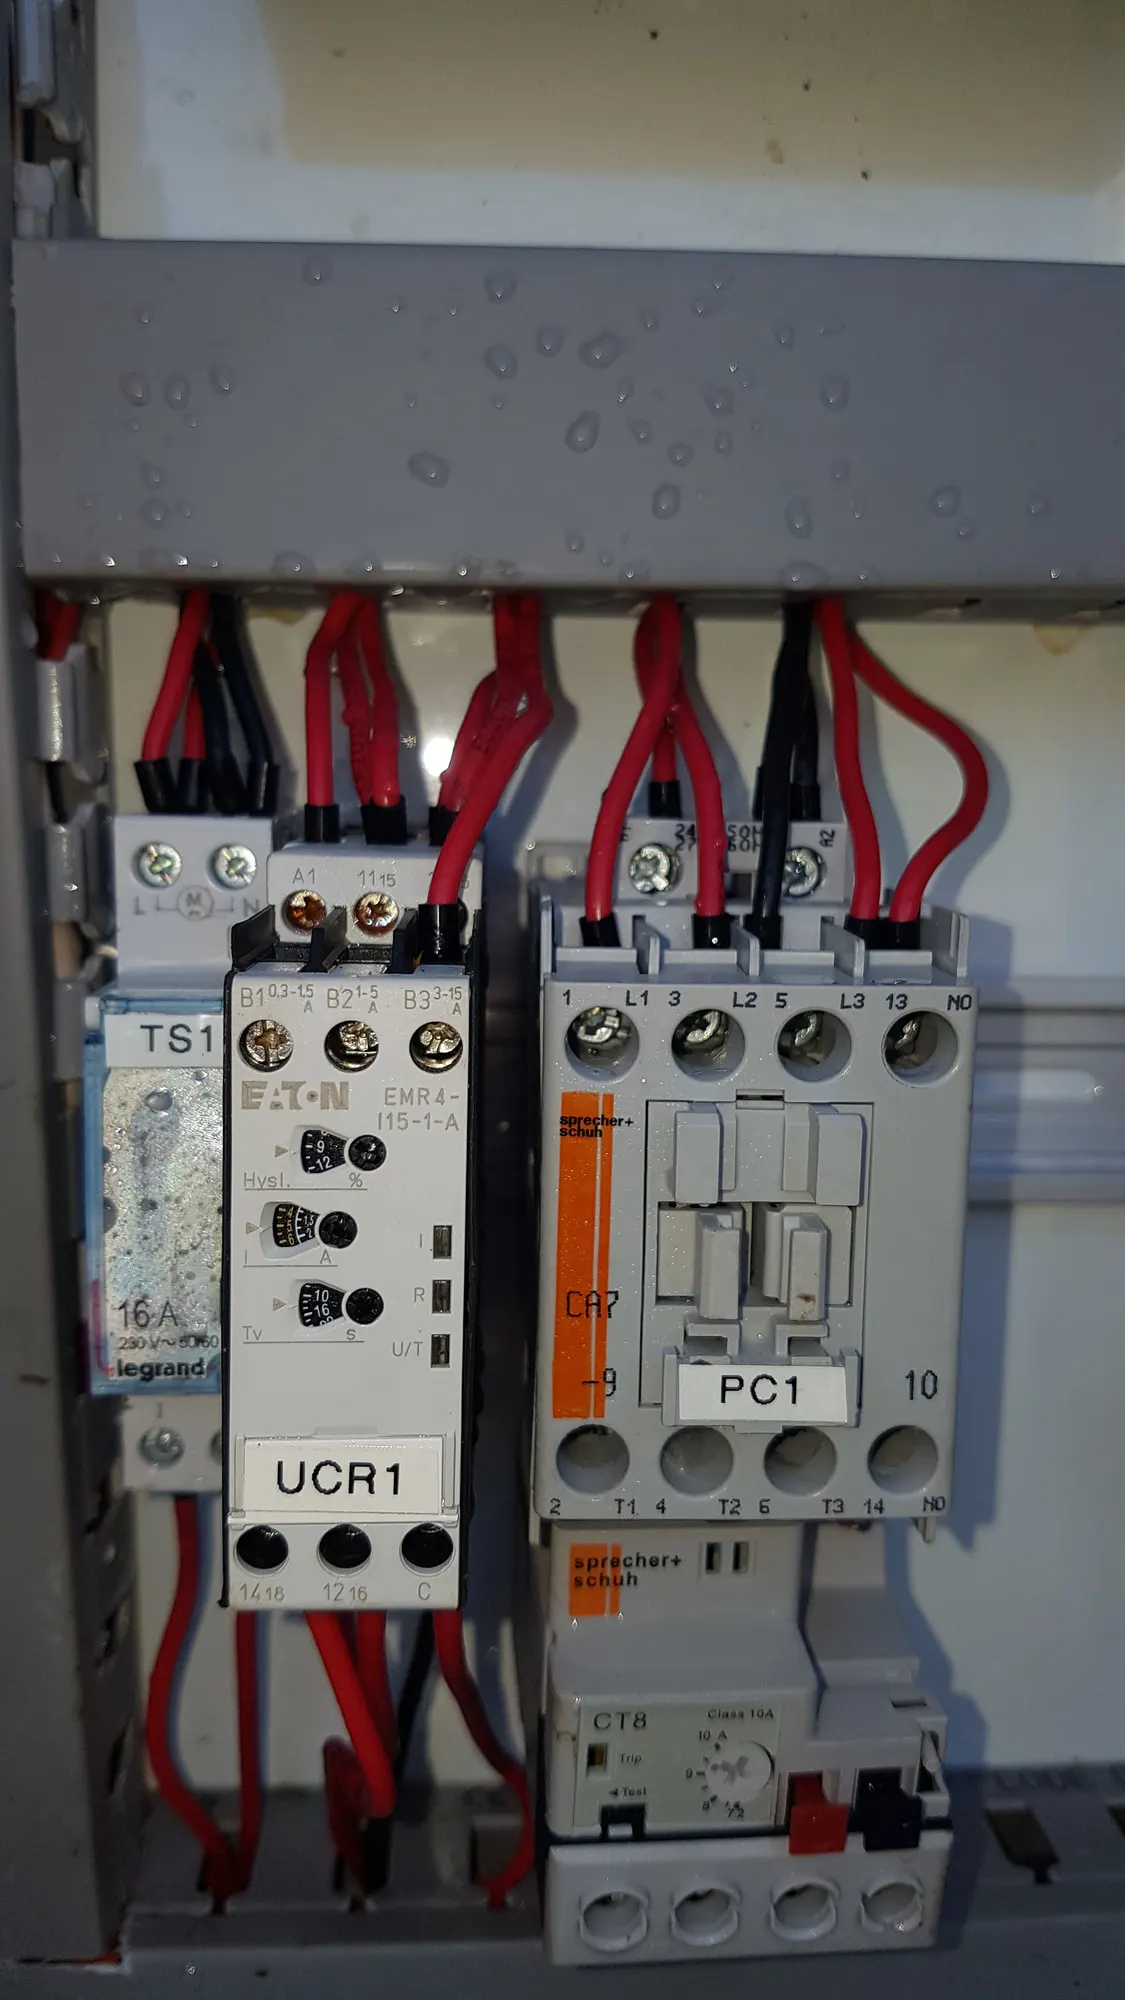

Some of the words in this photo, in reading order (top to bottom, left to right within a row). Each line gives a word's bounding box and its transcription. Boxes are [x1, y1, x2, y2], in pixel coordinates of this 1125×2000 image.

[726, 824, 762, 838] 50H
[293, 867, 316, 885] A1
[240, 986, 265, 1008] B1
[326, 988, 354, 1009] B2
[403, 989, 431, 1010] B3
[433, 986, 463, 1001] 3-15
[562, 990, 572, 1006] 1
[625, 990, 649, 1007] L1
[668, 991, 682, 1007] 3
[732, 992, 757, 1009] L2
[775, 992, 788, 1009] 5
[840, 992, 865, 1009] L3
[885, 993, 908, 1010] 13
[303, 1001, 313, 1013] A
[368, 1002, 378, 1014] A
[452, 1004, 462, 1016] A
[140, 1023, 213, 1054] TS1
[241, 1080, 350, 1111] EATON
[559, 1126, 603, 1138] schuh
[316, 1139, 325, 1154] 9
[316, 1155, 333, 1171] 12
[349, 1172, 363, 1188] %
[319, 1249, 332, 1264] A
[314, 1288, 329, 1302] 10
[414, 1287, 426, 1302] R
[314, 1303, 330, 1317] 16
[566, 1290, 619, 1319] CA7
[118, 1299, 149, 1328] 16
[158, 1300, 179, 1328] A
[242, 1325, 263, 1341] Tv
[119, 1336, 145, 1350] 230
[391, 1340, 423, 1357] U/T
[117, 1358, 205, 1380] legrand
[720, 1373, 799, 1405] PC1
[905, 1368, 939, 1401] 10
[276, 1459, 401, 1495] UCR1
[550, 1499, 562, 1516] 2
[614, 1498, 636, 1516] T1
[655, 1498, 667, 1515] 4
[719, 1499, 742, 1516] T2
[758, 1498, 771, 1515] 6
[821, 1498, 845, 1515] T3
[863, 1499, 885, 1515] 14
[573, 1553, 683, 1573] sprecher+
[573, 1571, 639, 1588] schuh
[417, 1581, 432, 1601] C
[592, 1711, 648, 1731] CT8
[707, 1708, 745, 1720] Class
[717, 1730, 728, 1741] A
[619, 1752, 642, 1765] Trip
[622, 1786, 647, 1797] Test
